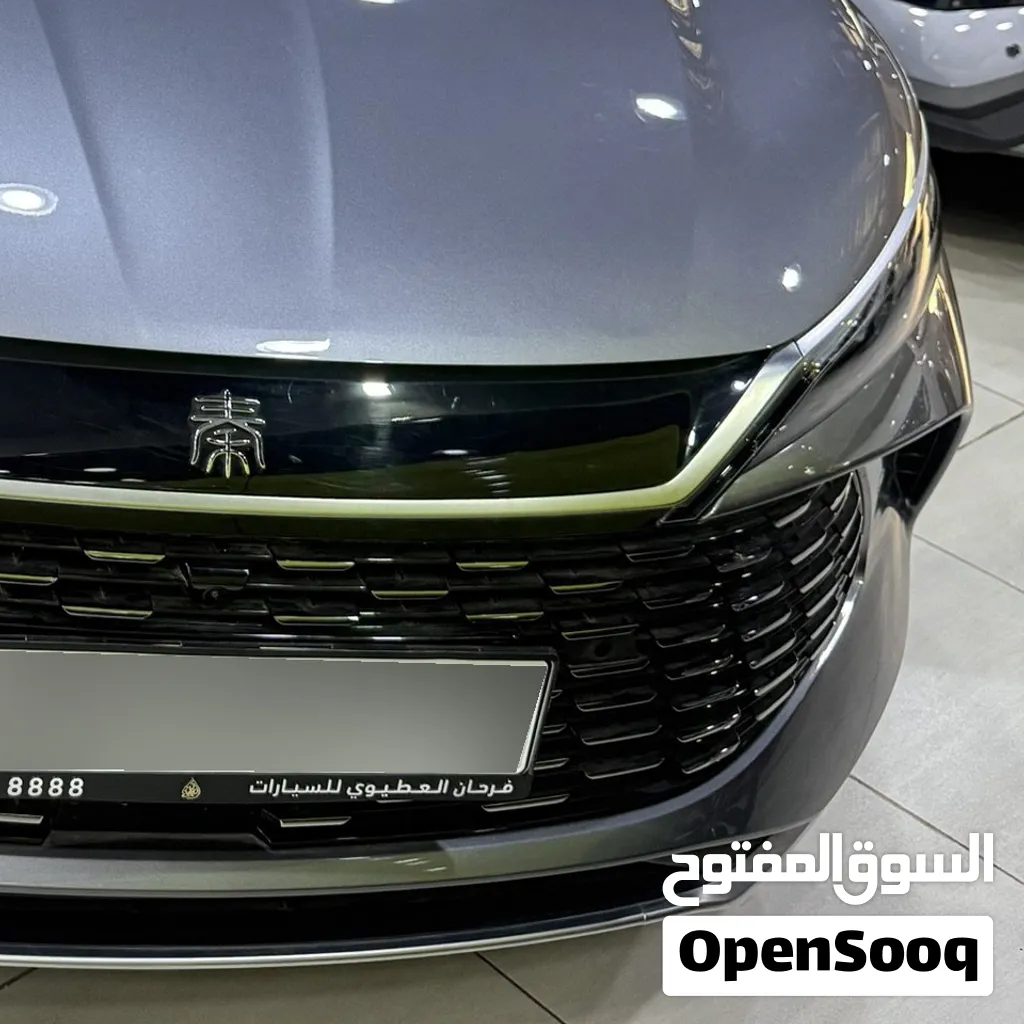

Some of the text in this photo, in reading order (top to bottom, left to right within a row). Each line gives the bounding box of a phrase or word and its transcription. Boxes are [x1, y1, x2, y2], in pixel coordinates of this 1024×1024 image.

[7, 776, 85, 797] 8888
[248, 778, 515, 799] فرحان العطيوي للسيارات
